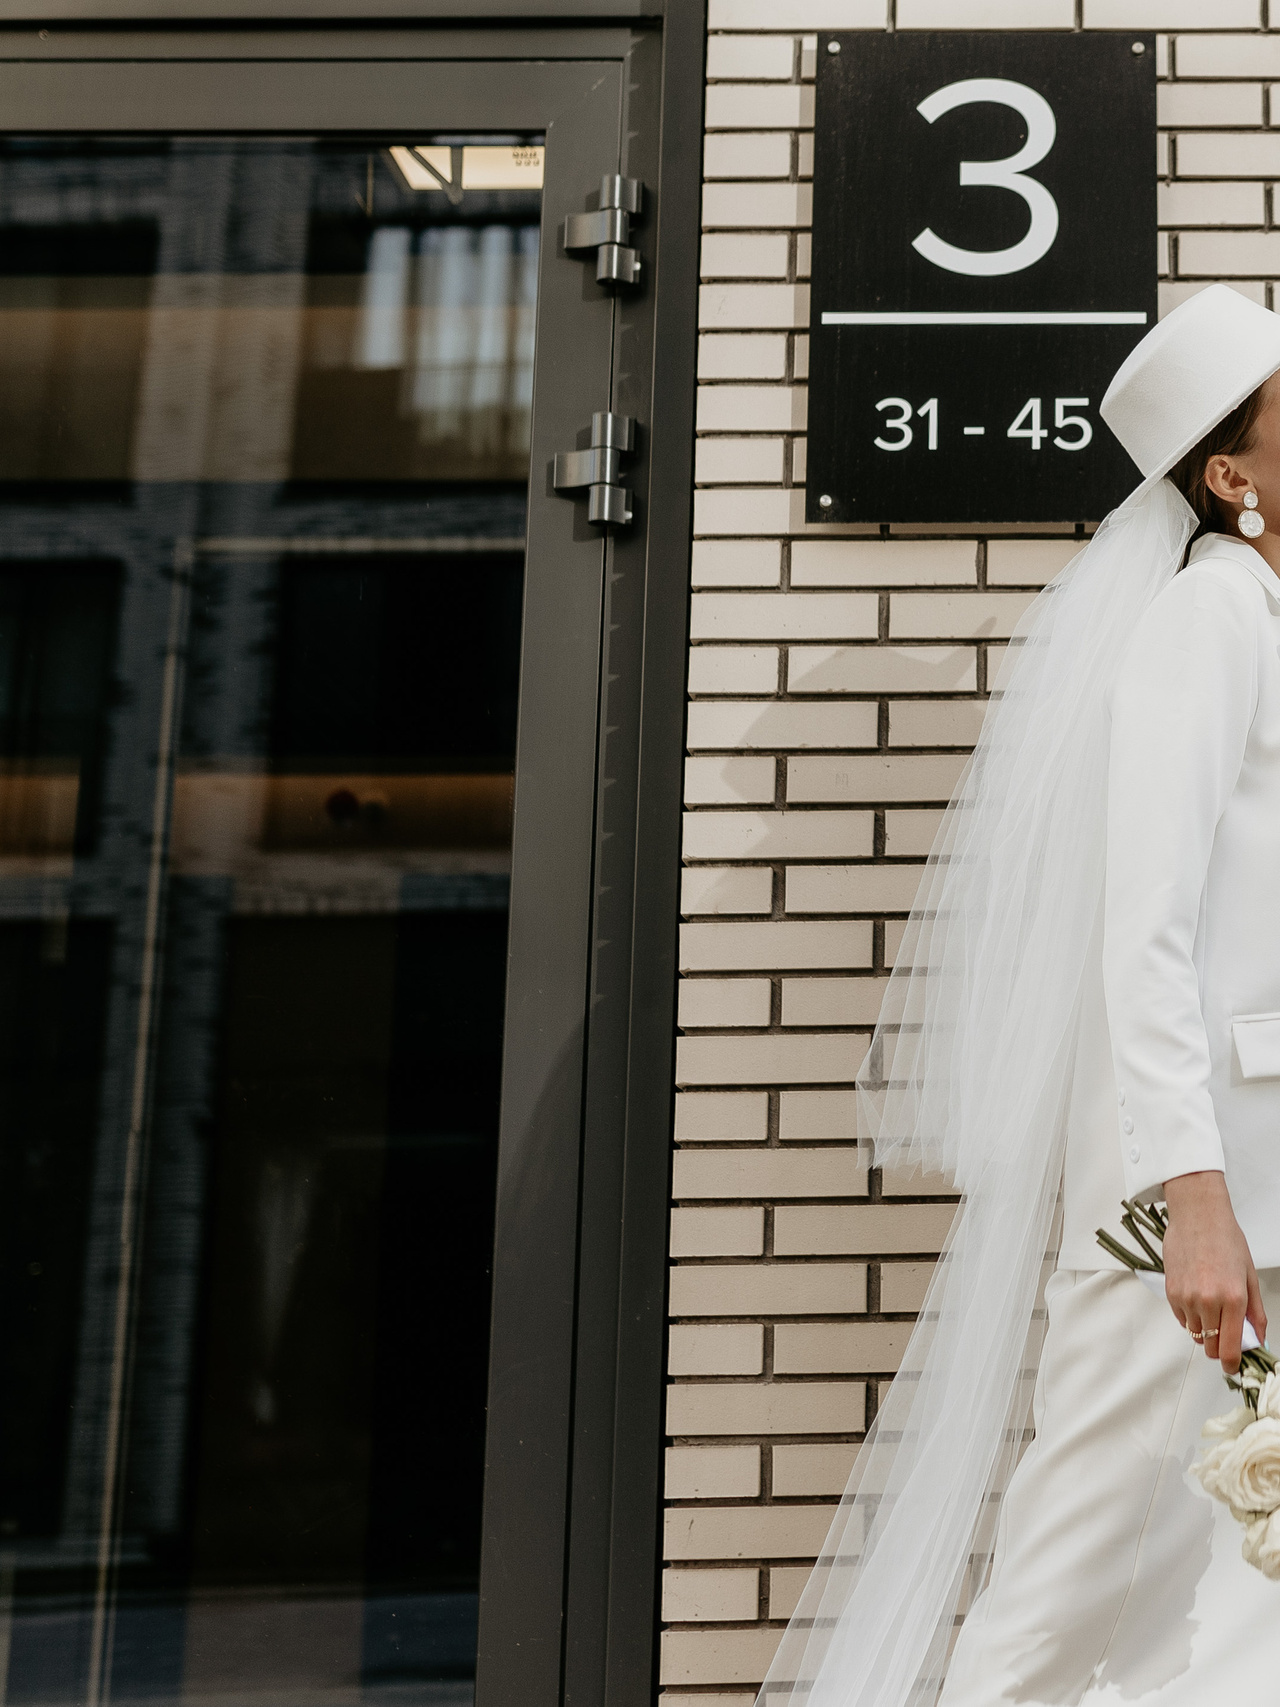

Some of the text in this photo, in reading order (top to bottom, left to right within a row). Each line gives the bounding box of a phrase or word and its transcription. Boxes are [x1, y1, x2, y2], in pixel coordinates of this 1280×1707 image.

[911, 77, 1060, 277] 3
[873, 397, 1094, 452] 31 - 45
